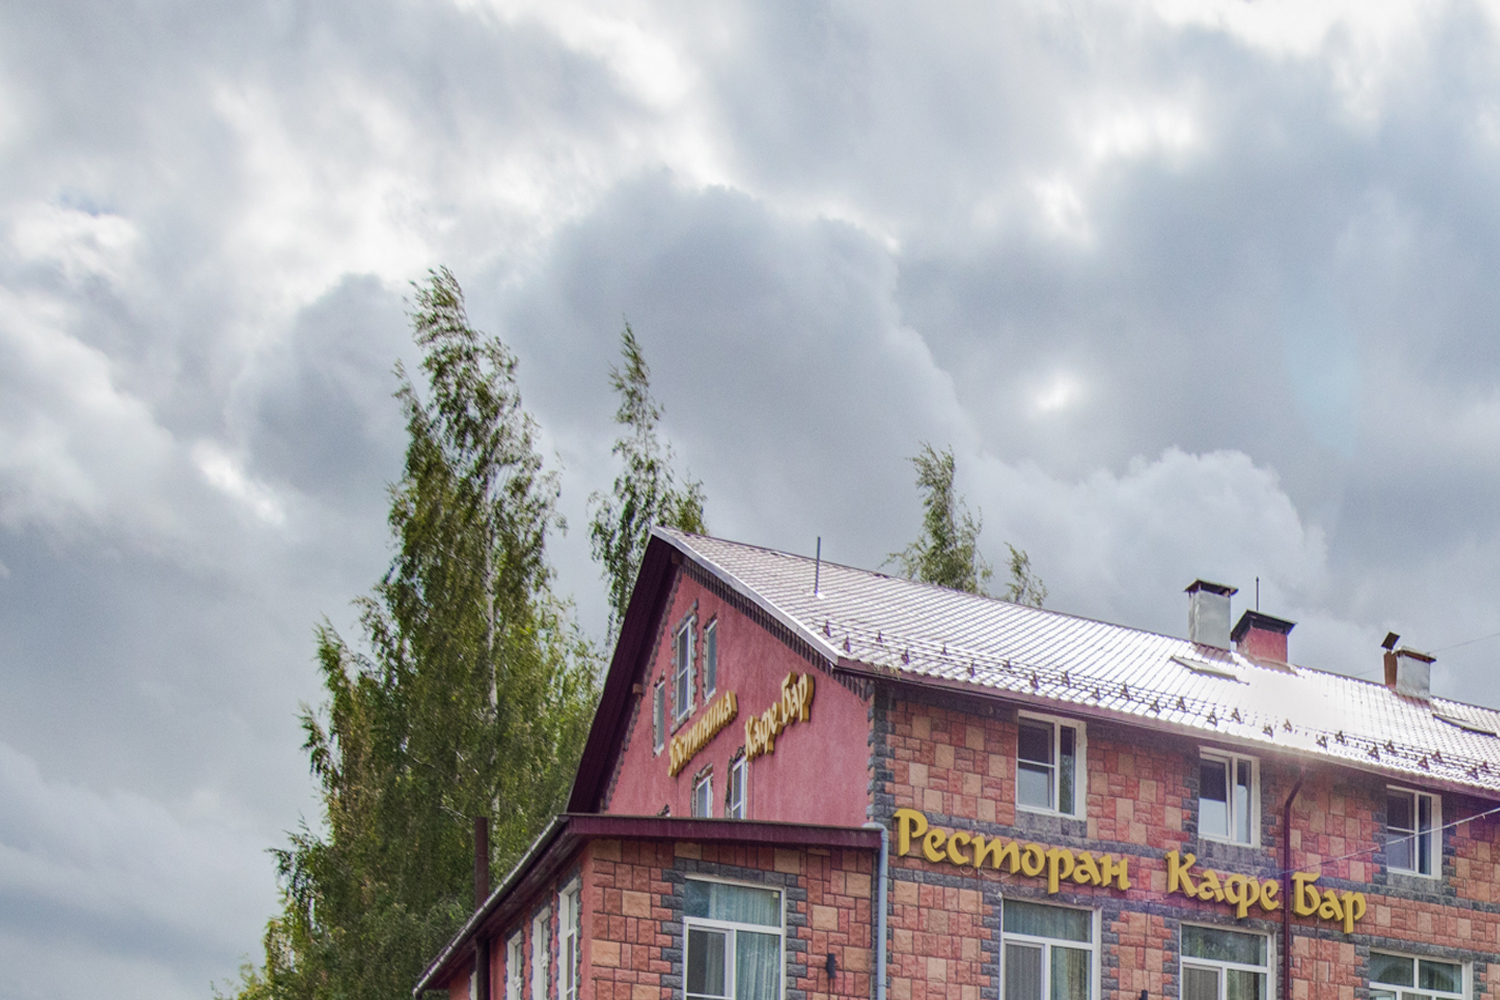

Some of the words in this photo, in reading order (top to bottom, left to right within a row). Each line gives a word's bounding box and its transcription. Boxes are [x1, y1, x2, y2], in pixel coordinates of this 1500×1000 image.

[744, 701, 783, 763] Кафе
[780, 670, 815, 723] Бар
[893, 808, 1131, 895] Ресторан
[1164, 849, 1281, 919] Кафе
[1291, 871, 1367, 934] Бар
